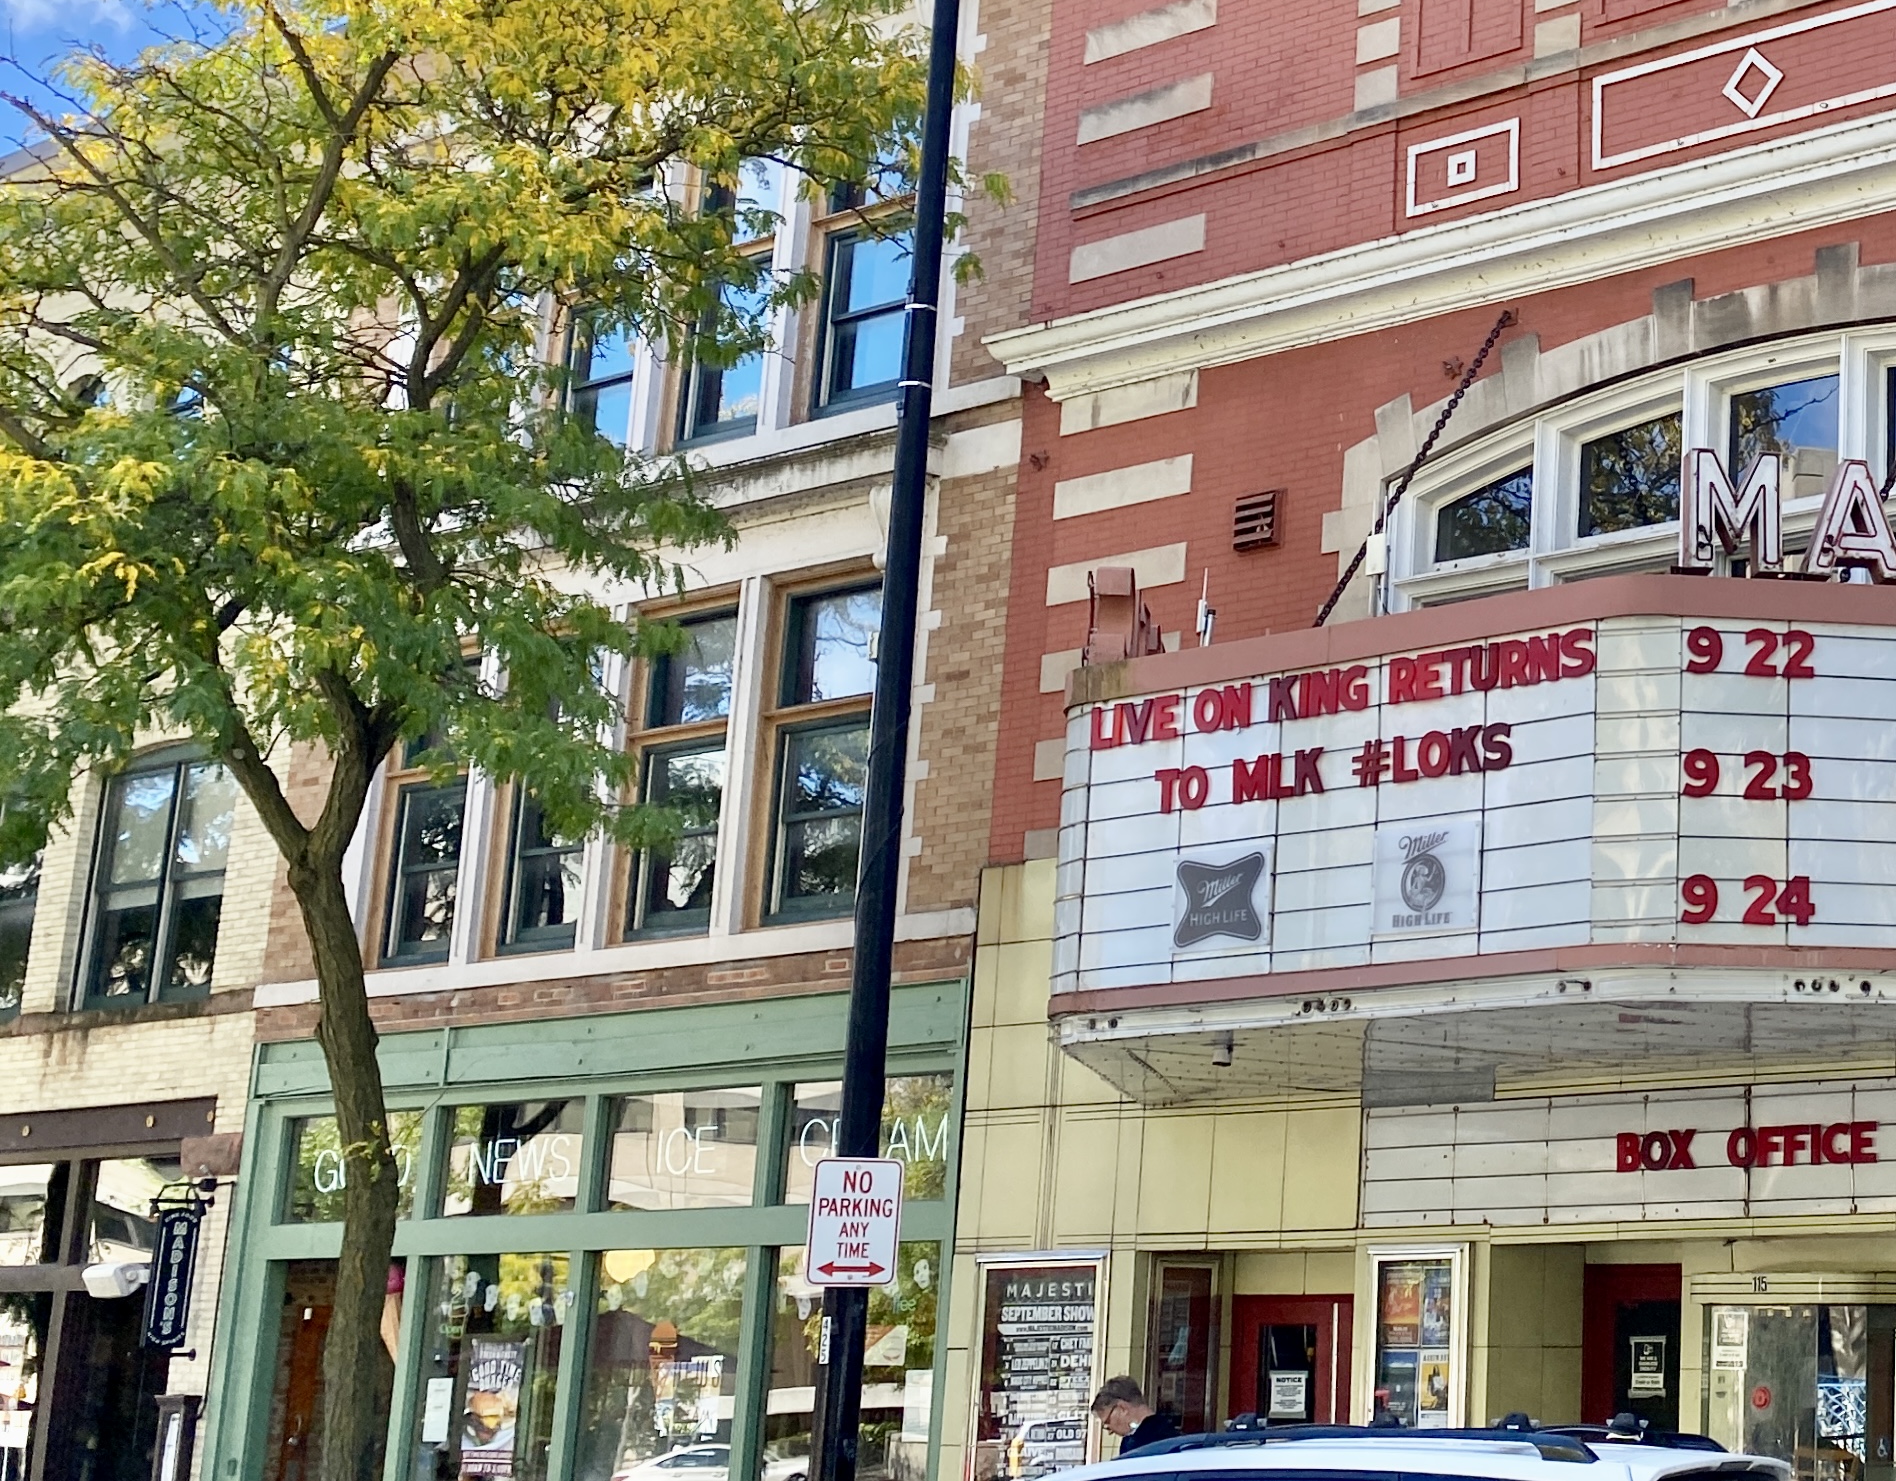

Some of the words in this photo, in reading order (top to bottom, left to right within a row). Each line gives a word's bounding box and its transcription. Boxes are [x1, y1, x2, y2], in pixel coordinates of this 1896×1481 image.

[1686, 626, 1723, 675] 9
[1743, 628, 1815, 680] 22
[1089, 693, 1181, 751] LIVE
[1193, 681, 1253, 734] ON
[1268, 665, 1370, 722] KING
[1387, 627, 1597, 706] RETURNS
[1154, 765, 1209, 814] TO
[1231, 746, 1325, 805] MLK
[1352, 723, 1513, 788] #LOKS
[1682, 748, 1720, 799] 9
[1743, 750, 1814, 801] 23
[1398, 831, 1449, 863] Miller
[1197, 872, 1244, 906] Miller
[1680, 873, 1719, 925] 9
[1742, 874, 1816, 926] 24
[1189, 911, 1220, 927] HIGH
[1223, 909, 1248, 924] LIFE
[1392, 914, 1422, 928] HIGH
[1424, 912, 1451, 926] LIFE
[467, 1135, 571, 1186] NEWS
[655, 1125, 719, 1176] ICE
[1616, 1129, 1698, 1173] BOX
[1726, 1121, 1879, 1167] OFFICE
[843, 1171, 873, 1194] NO
[818, 1197, 893, 1219] PARKING
[838, 1222, 869, 1238] ANY
[837, 1242, 870, 1259] TIME
[159, 1221, 188, 1336] MADISON'S
[1752, 1276, 1768, 1292] 115
[1001, 1306, 1062, 1322] SEPTEMBER
